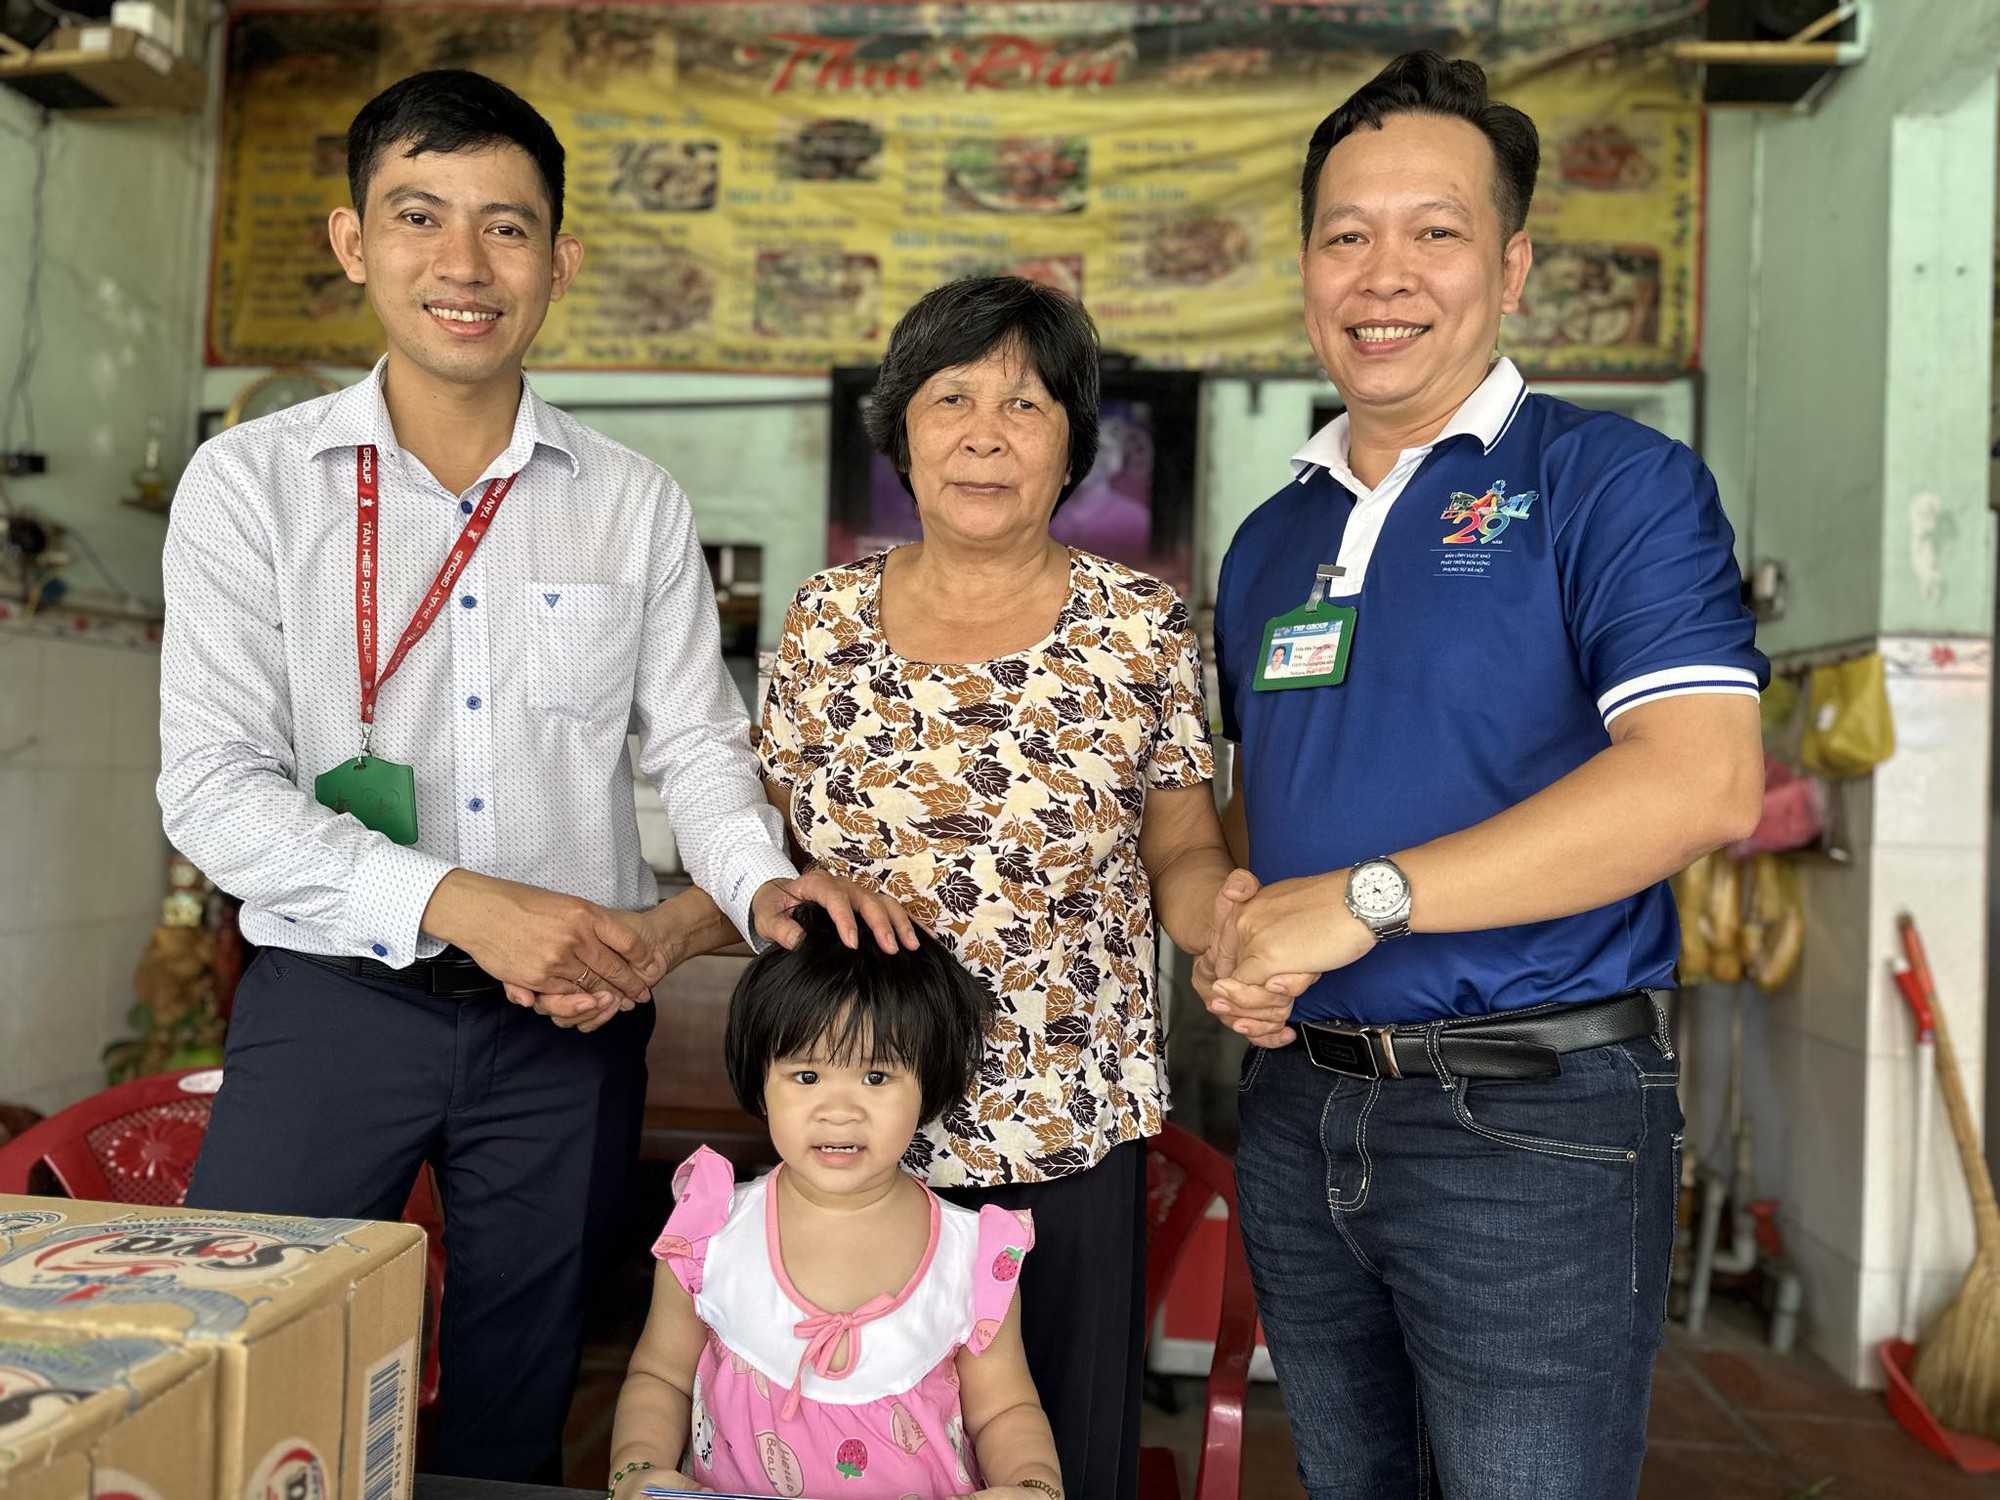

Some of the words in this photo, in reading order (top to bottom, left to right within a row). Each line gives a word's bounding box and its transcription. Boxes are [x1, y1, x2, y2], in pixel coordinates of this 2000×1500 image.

[361, 447, 373, 484] GROUP
[479, 497, 496, 520] TÂN
[361, 521, 374, 546] TÂN
[1442, 509, 1511, 545] 29
[359, 548, 373, 578] HIỆP
[361, 580, 373, 616] PHÁT
[424, 591, 443, 620] PHÁT
[440, 549, 464, 588] GROUP
[361, 619, 373, 664] GROUP
